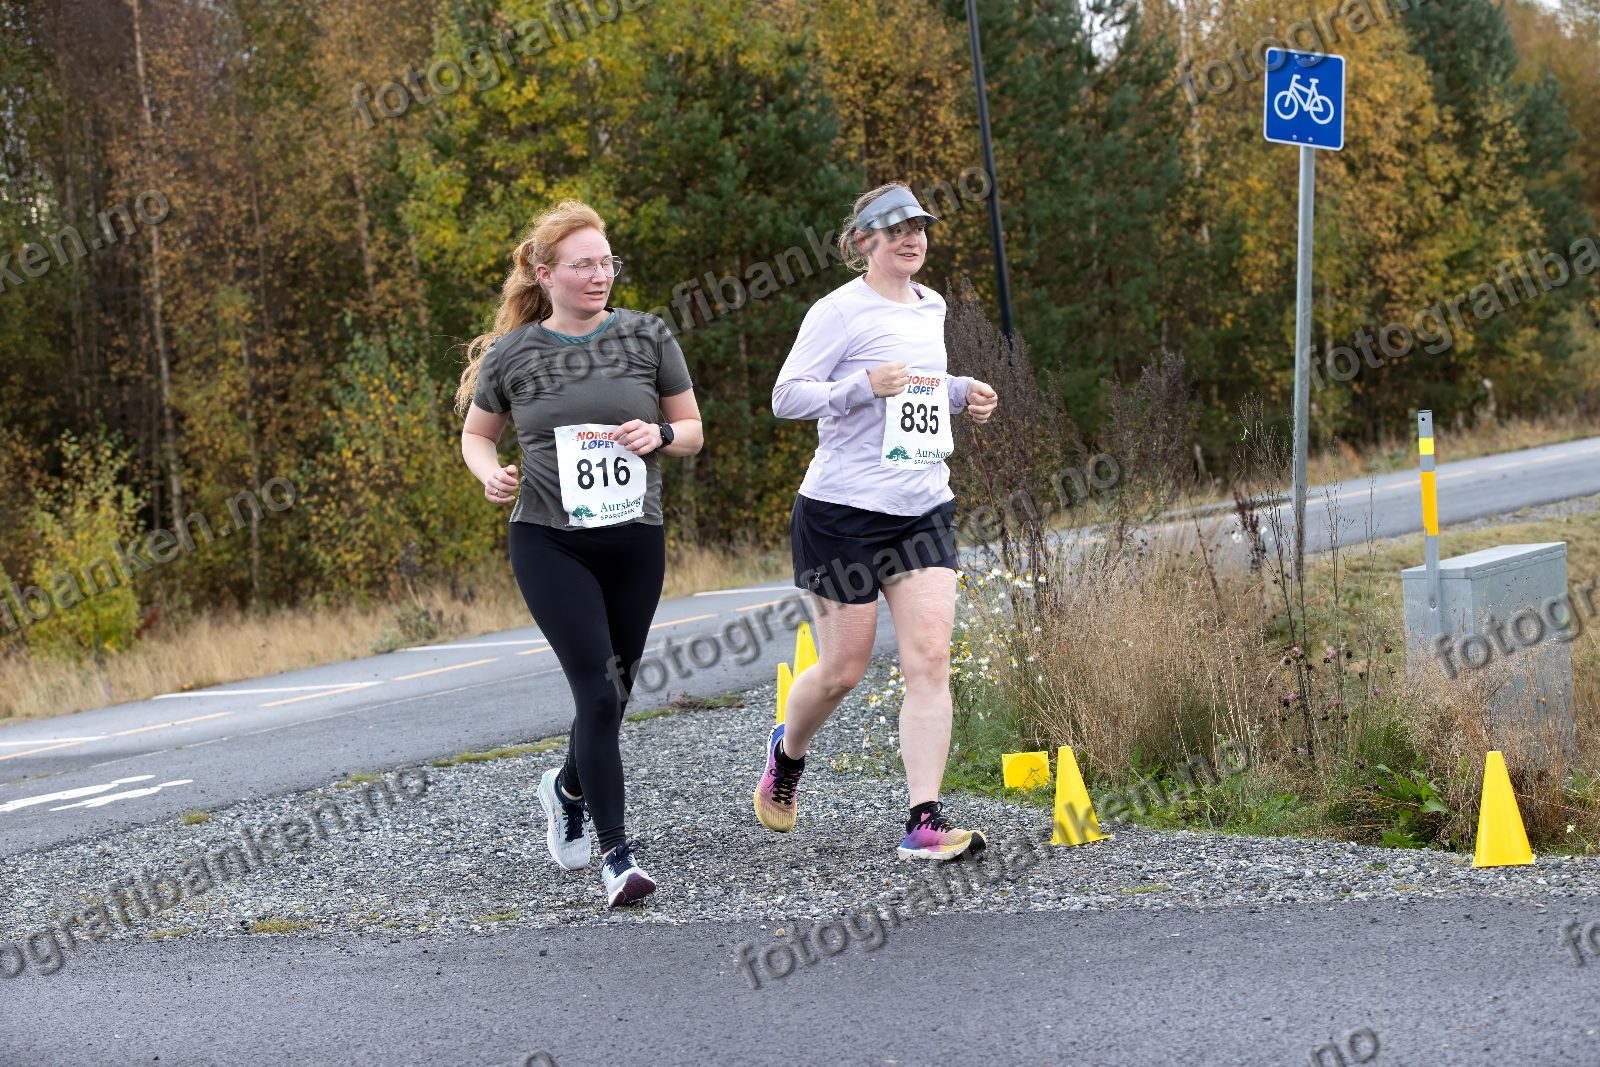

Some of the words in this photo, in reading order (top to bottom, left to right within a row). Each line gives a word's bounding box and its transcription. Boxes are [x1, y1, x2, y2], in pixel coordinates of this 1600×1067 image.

[907, 385, 935, 396] LØPET
[900, 402, 939, 434] 835
[576, 431, 614, 441] NORGE
[581, 440, 615, 451] LØPET
[576, 457, 631, 490] 816
[600, 498, 641, 513] Aurskog
